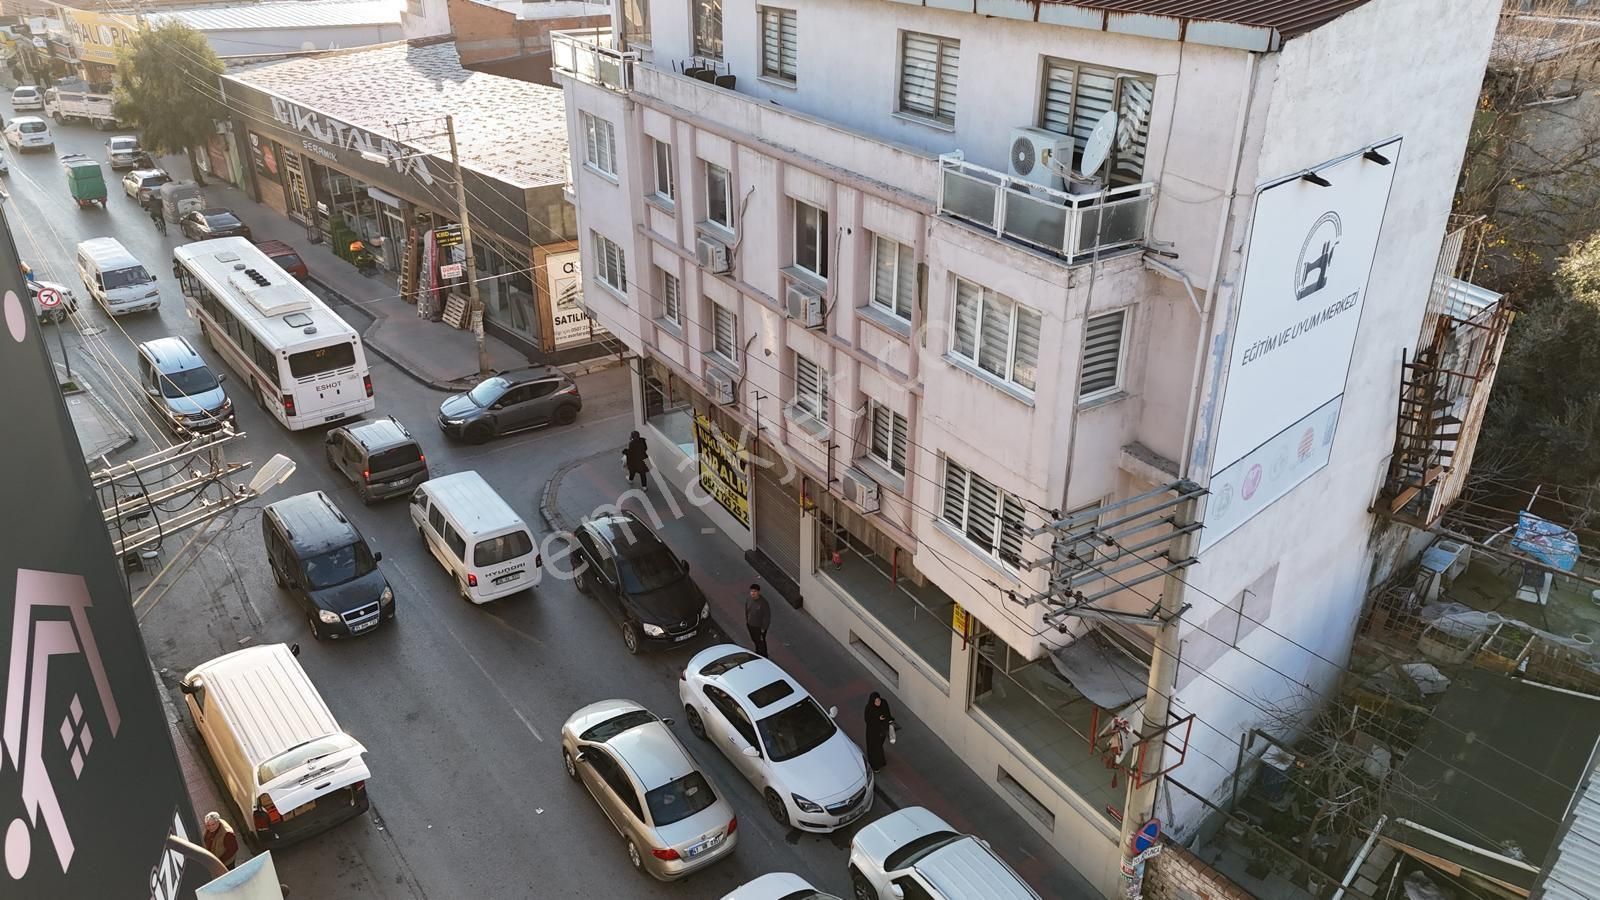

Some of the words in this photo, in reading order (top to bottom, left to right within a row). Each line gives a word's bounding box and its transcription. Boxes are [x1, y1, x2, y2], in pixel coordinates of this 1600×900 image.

[1242, 335, 1277, 366] EĞİTİM
[1278, 327, 1292, 347] VE
[1292, 312, 1321, 339] UYUM
[1320, 288, 1360, 324] MERKEZİ
[316, 381, 342, 392] ESHOT
[484, 562, 526, 578] HYUNDAI
